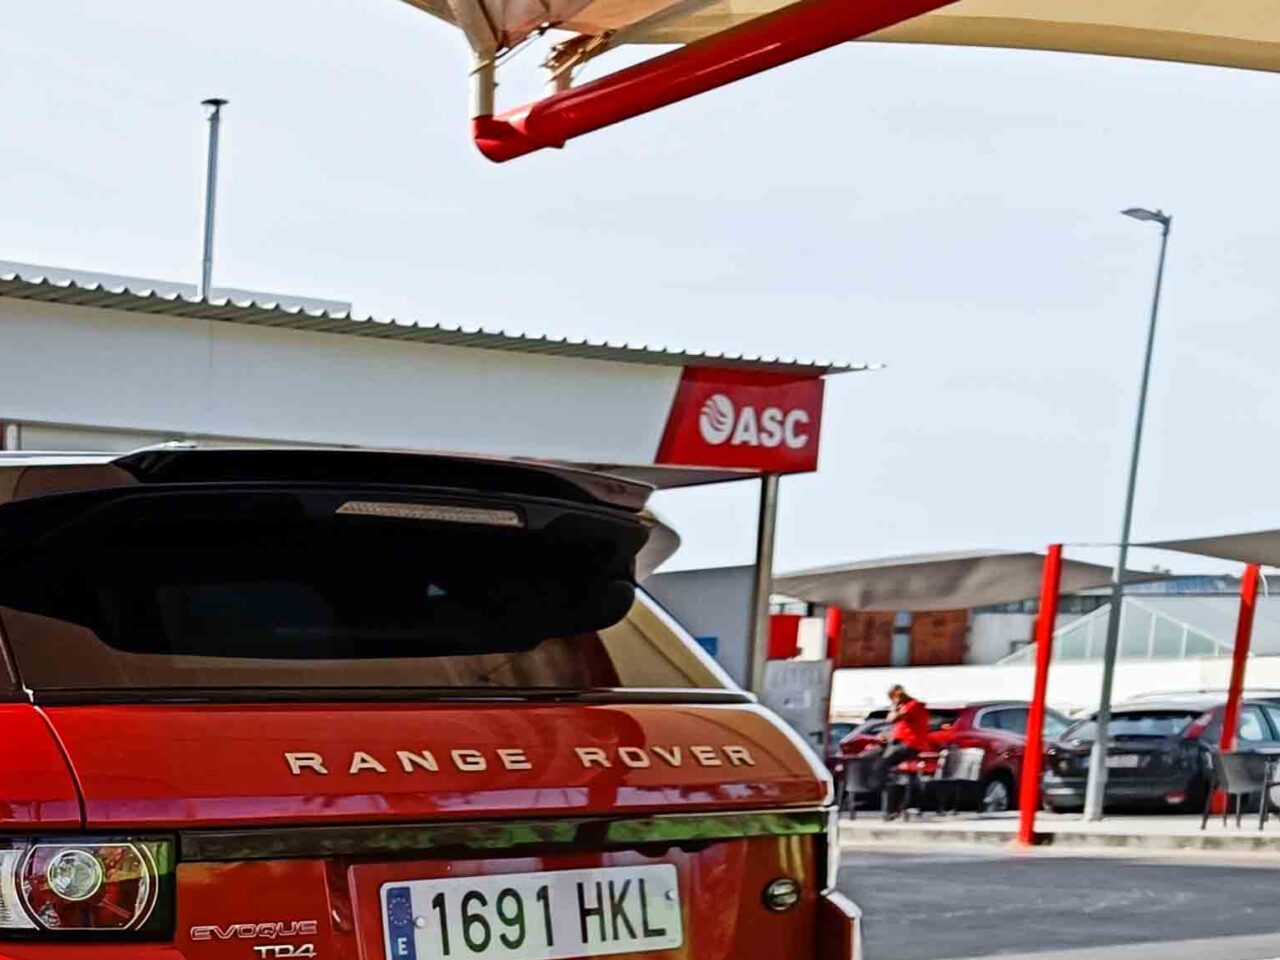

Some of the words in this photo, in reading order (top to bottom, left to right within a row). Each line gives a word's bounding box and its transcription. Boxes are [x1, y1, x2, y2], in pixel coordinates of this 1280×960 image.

[730, 405, 810, 449] ASC
[284, 747, 533, 776] RANGE
[573, 745, 756, 769] ROVER
[431, 884, 554, 957] 1691
[576, 877, 667, 944] HKL
[190, 920, 318, 941] EVOQUE
[253, 943, 317, 959] TD4
[397, 937, 408, 956] E
